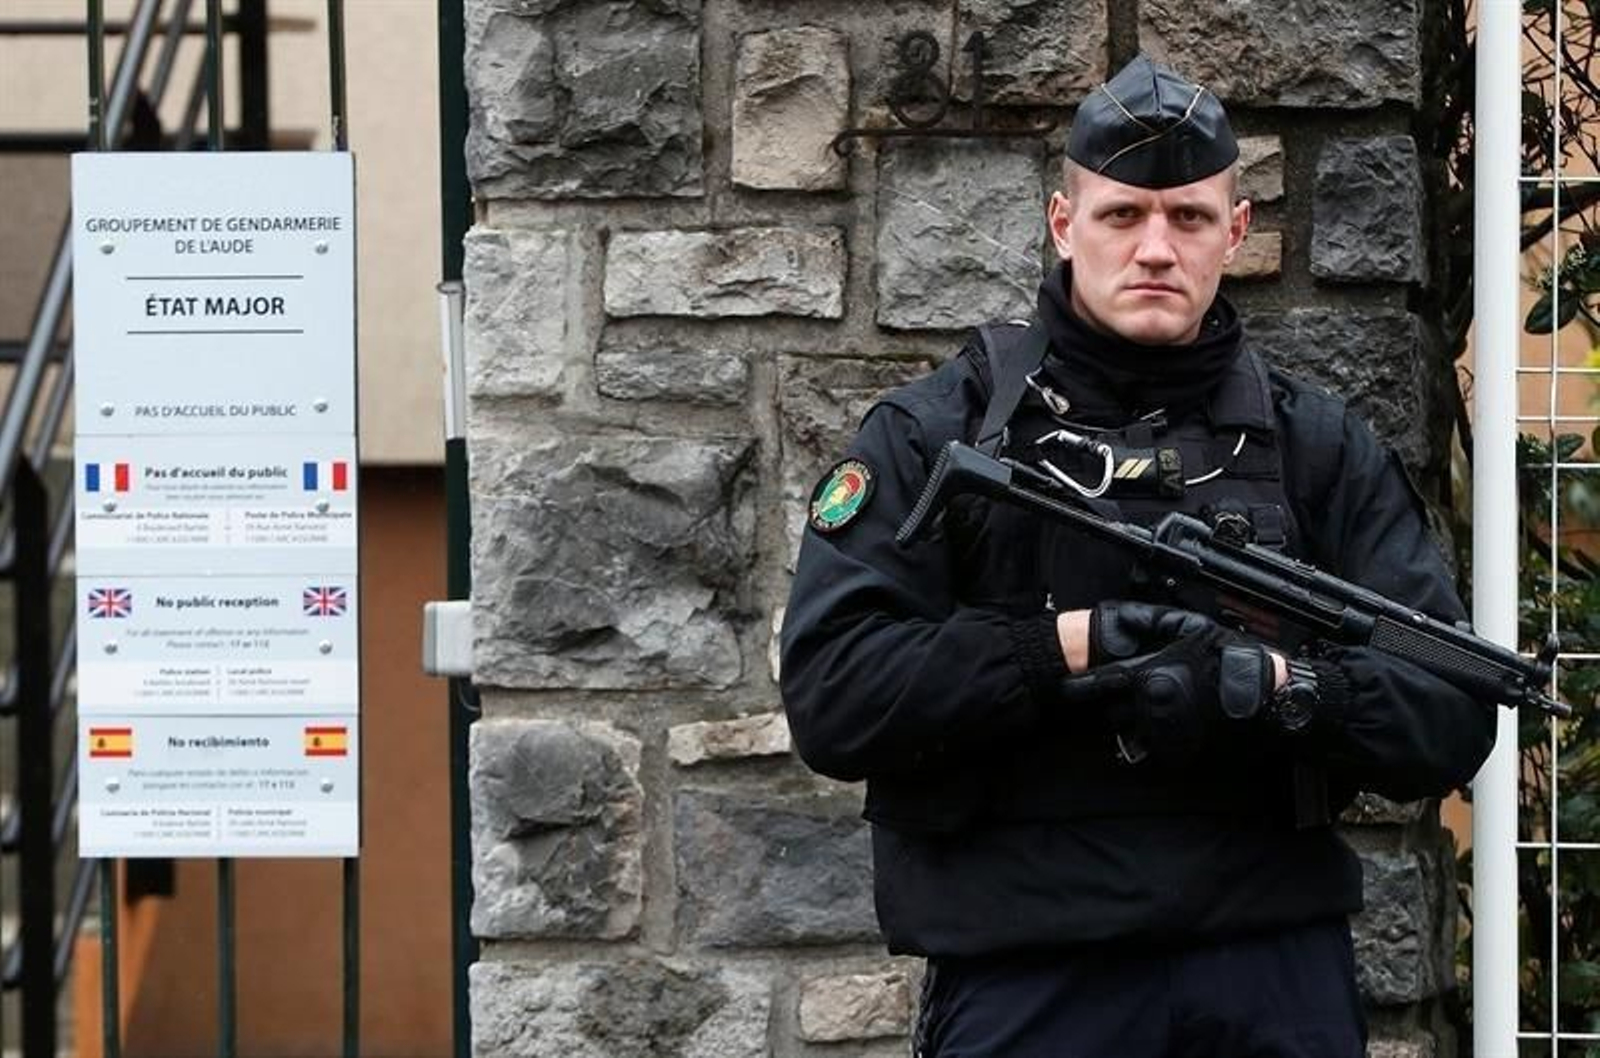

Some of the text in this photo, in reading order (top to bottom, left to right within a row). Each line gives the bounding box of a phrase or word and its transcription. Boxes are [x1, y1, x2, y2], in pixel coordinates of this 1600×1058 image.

[85, 216, 341, 232] GROUPEMENT DE GENDARMERIE
[174, 239, 254, 254] DE L'AUDE
[145, 294, 285, 316] ÉTAT MAJOR
[135, 404, 296, 418] PAS D'ACCUEIL DU PUBLIC
[144, 466, 288, 481] Pas d'accueil du public
[155, 596, 280, 612] No public reception
[168, 736, 270, 748] No recibimiento
